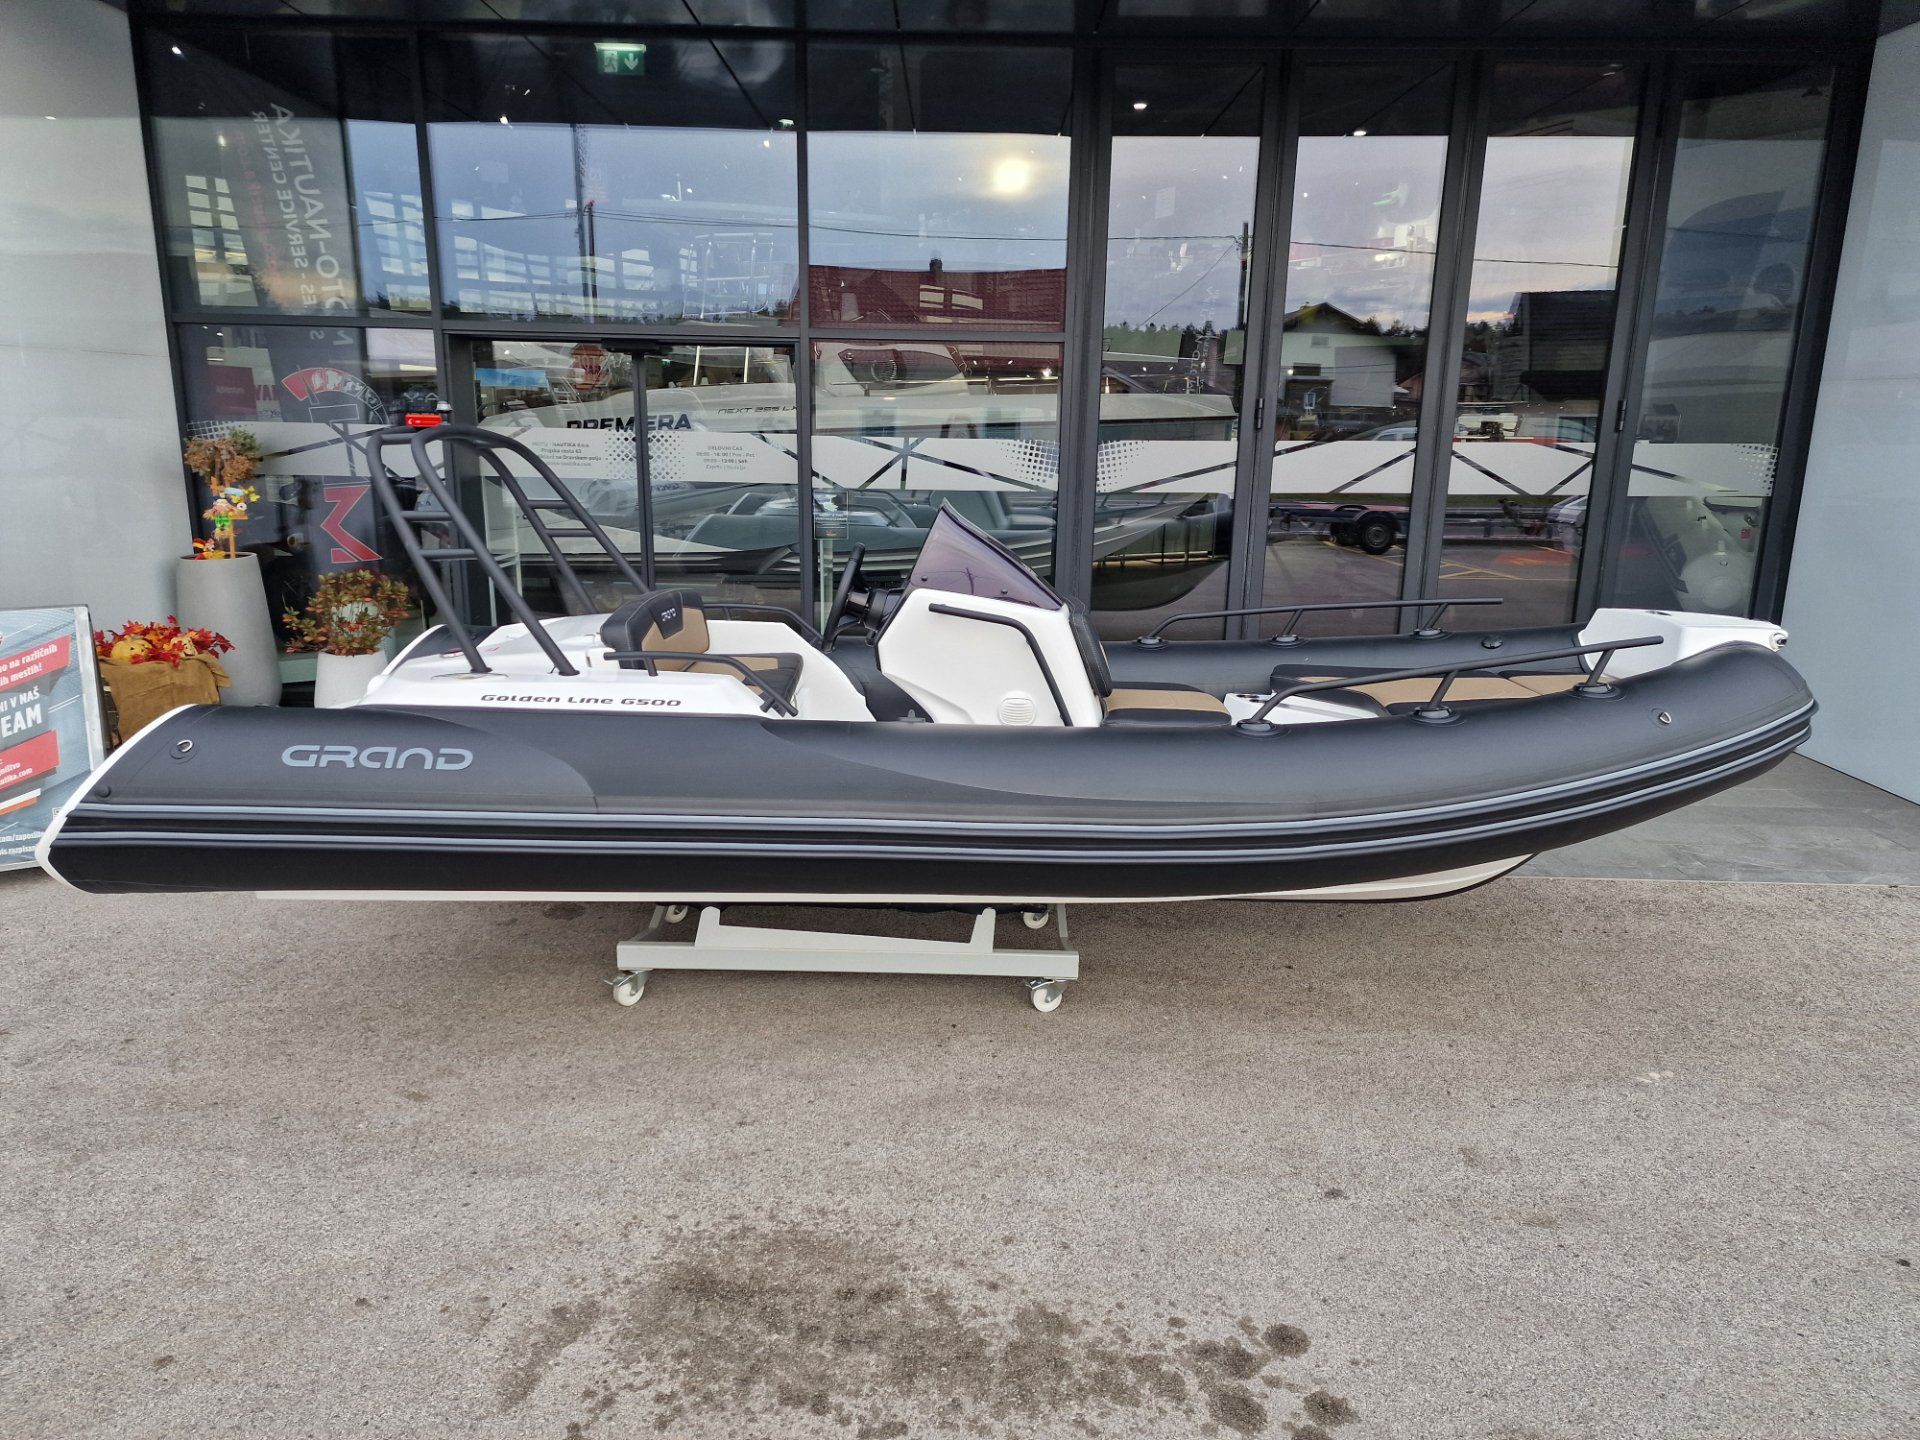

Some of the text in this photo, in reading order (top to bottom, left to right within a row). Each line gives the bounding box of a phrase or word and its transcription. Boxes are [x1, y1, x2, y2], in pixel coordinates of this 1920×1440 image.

[10, 697, 17, 708] V
[19, 685, 40, 705] NAŠ
[480, 694, 682, 707] Golden Line G500
[281, 744, 474, 771] GRAND
